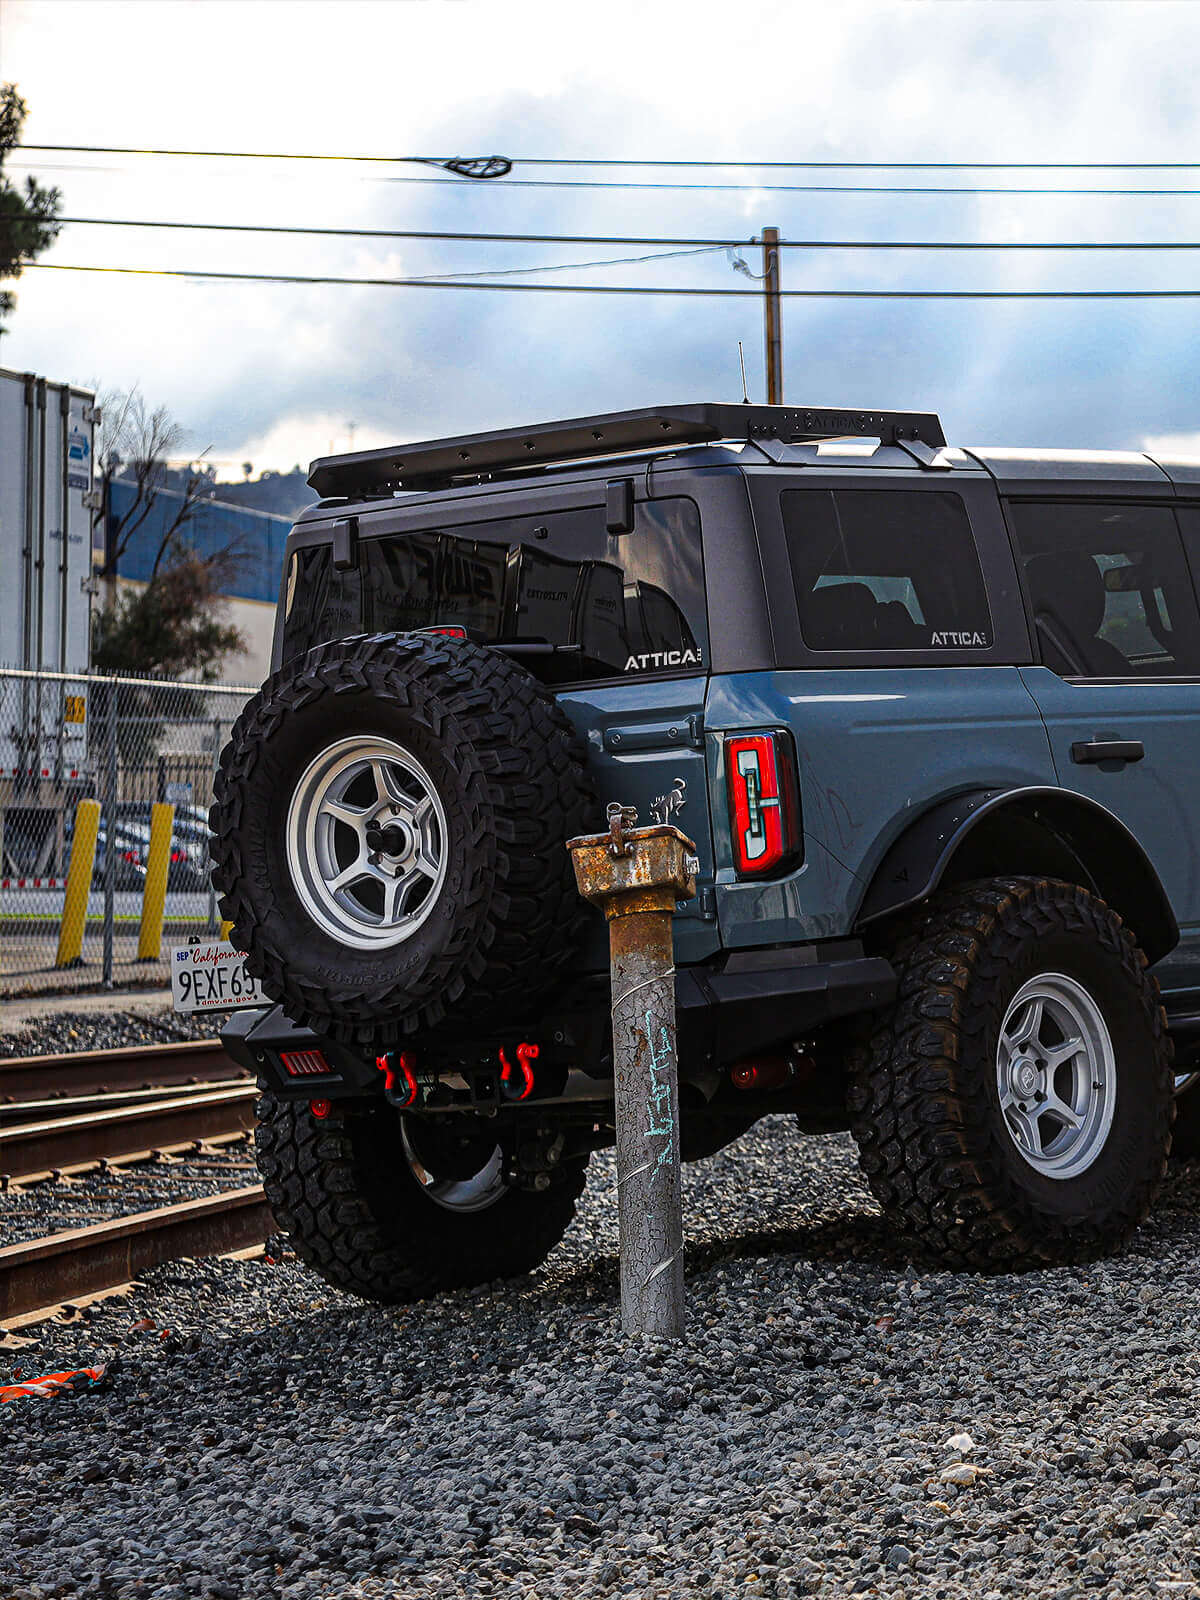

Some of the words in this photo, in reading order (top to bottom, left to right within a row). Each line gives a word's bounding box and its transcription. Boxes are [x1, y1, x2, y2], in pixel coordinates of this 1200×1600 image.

[931, 632, 983, 645] ATTICA
[624, 649, 697, 671] ATTICA
[177, 952, 189, 961] SEP
[193, 946, 249, 966] California
[179, 965, 263, 1001] 9EXF65
[202, 996, 252, 1006] dmv.ca.gov
